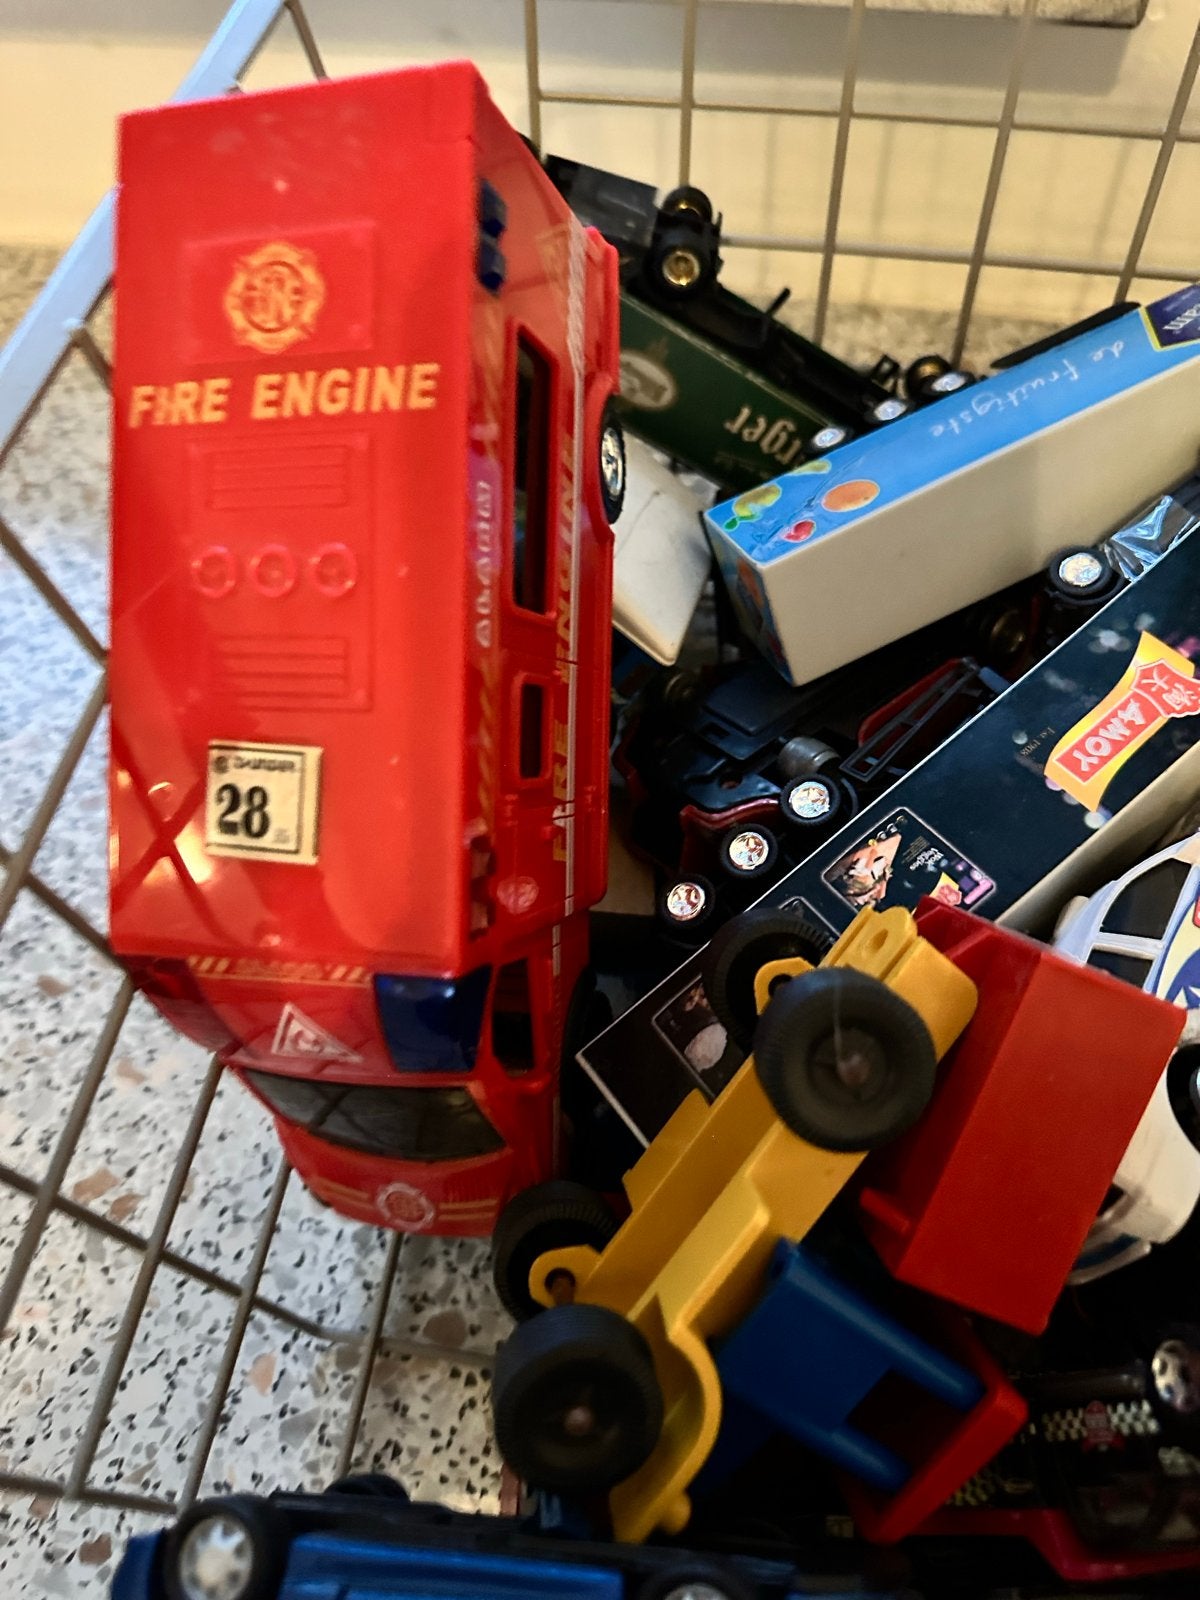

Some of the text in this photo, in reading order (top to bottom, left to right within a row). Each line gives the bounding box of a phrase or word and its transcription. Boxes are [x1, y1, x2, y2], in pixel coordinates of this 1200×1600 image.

[127, 364, 440, 428] FIRE ENGINE
[929, 338, 1125, 435] de fruitigste
[724, 406, 805, 466] rger
[1072, 698, 1148, 772] AMOY
[216, 784, 270, 838] 28
